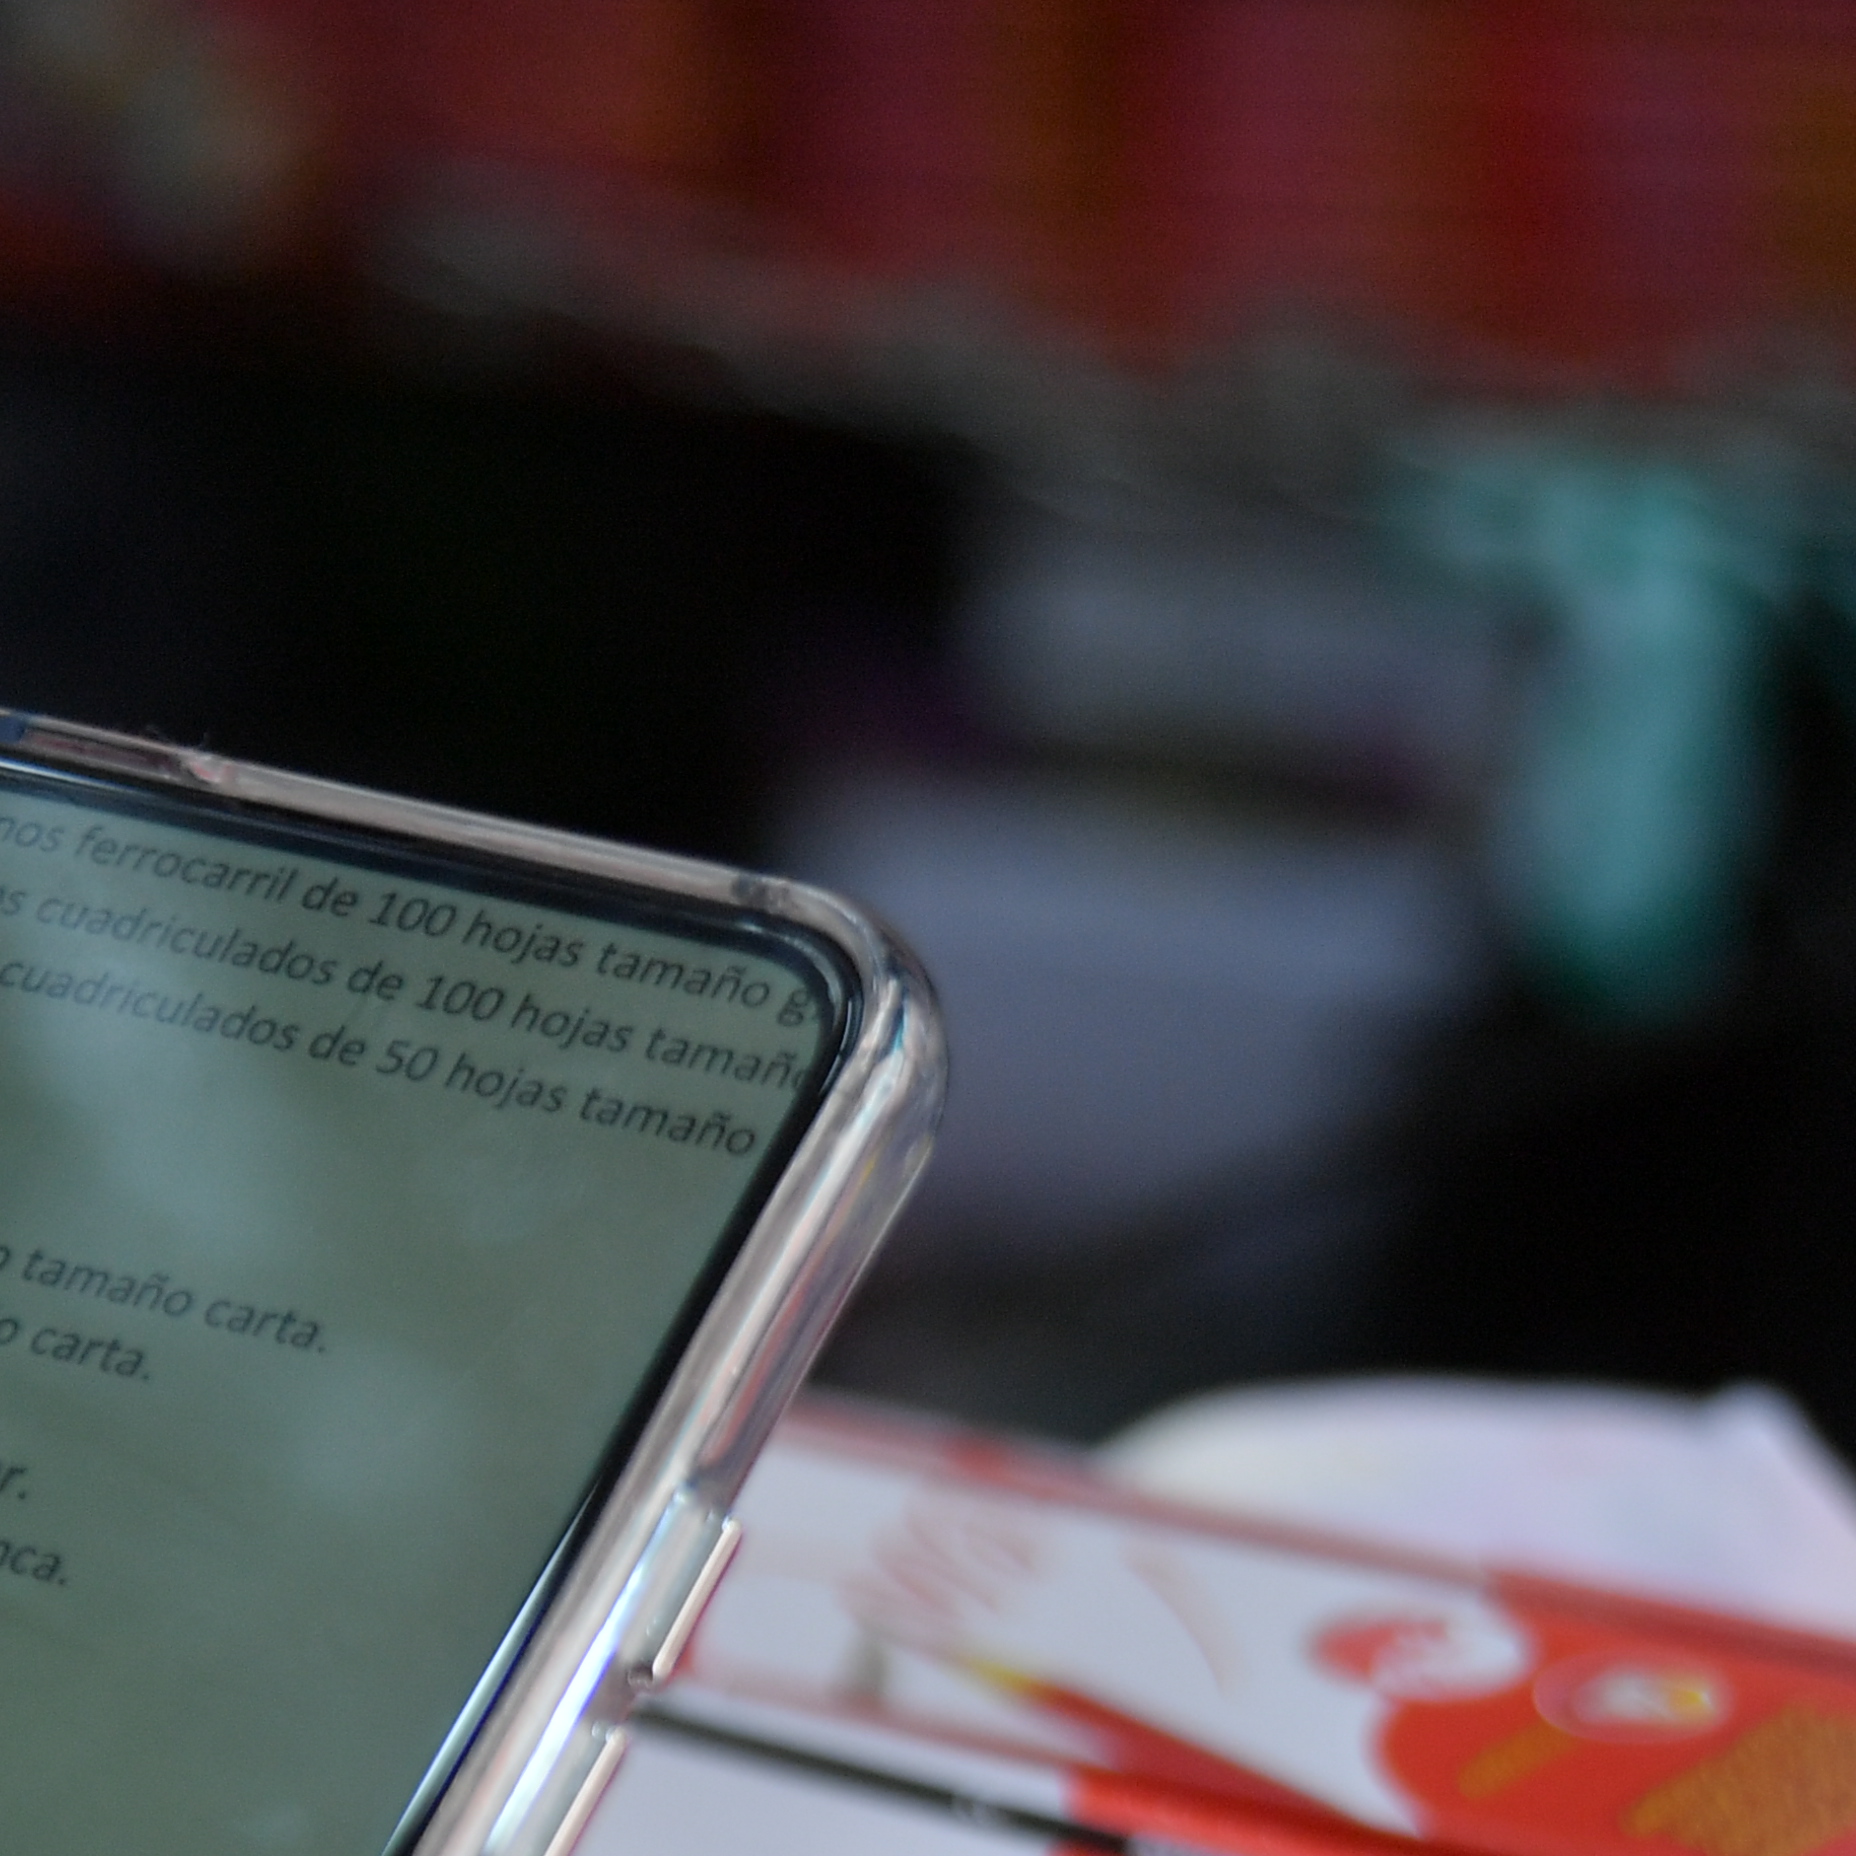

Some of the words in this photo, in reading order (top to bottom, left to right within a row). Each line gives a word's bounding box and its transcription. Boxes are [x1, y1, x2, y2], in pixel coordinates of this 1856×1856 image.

[37, 897, 340, 986] cuadriculados
[346, 958, 406, 1002] de
[414, 973, 507, 1022] 100
[509, 991, 635, 1053] hojas
[76, 826, 299, 902] ferrocarril
[299, 877, 361, 918] de
[367, 891, 459, 938] 100
[461, 909, 586, 968] hojas
[595, 942, 772, 1009] tamaño
[307, 1024, 368, 1067] de
[375, 1039, 441, 1082] 50
[443, 1051, 568, 1114] hojas
[578, 1087, 759, 1157] tamaño
[21, 1248, 195, 1317] tamaño
[204, 1298, 325, 1352] carta.
[29, 1326, 149, 1381] carta.
